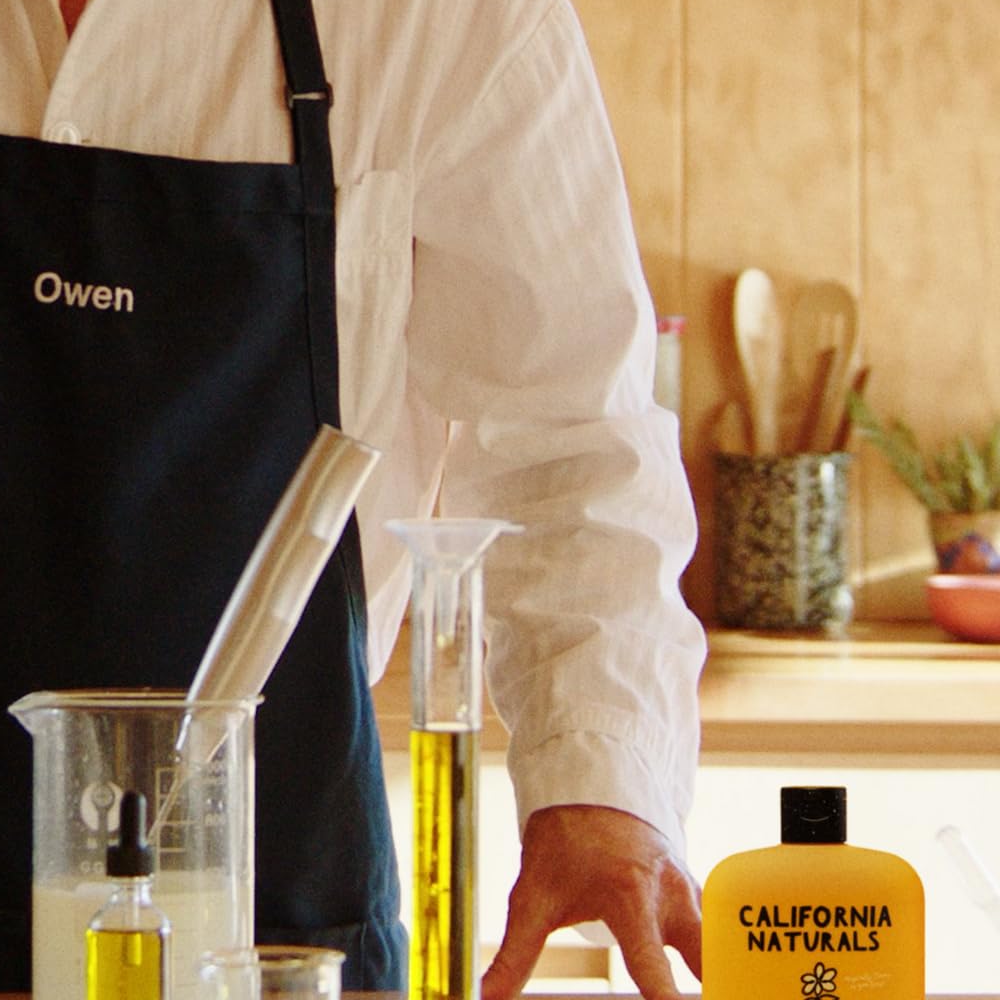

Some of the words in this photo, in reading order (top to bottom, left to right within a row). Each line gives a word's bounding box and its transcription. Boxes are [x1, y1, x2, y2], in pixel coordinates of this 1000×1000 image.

[34, 271, 134, 313] Owen
[739, 905, 892, 929] CALIFORNIA
[747, 930, 880, 953] NATURALS
